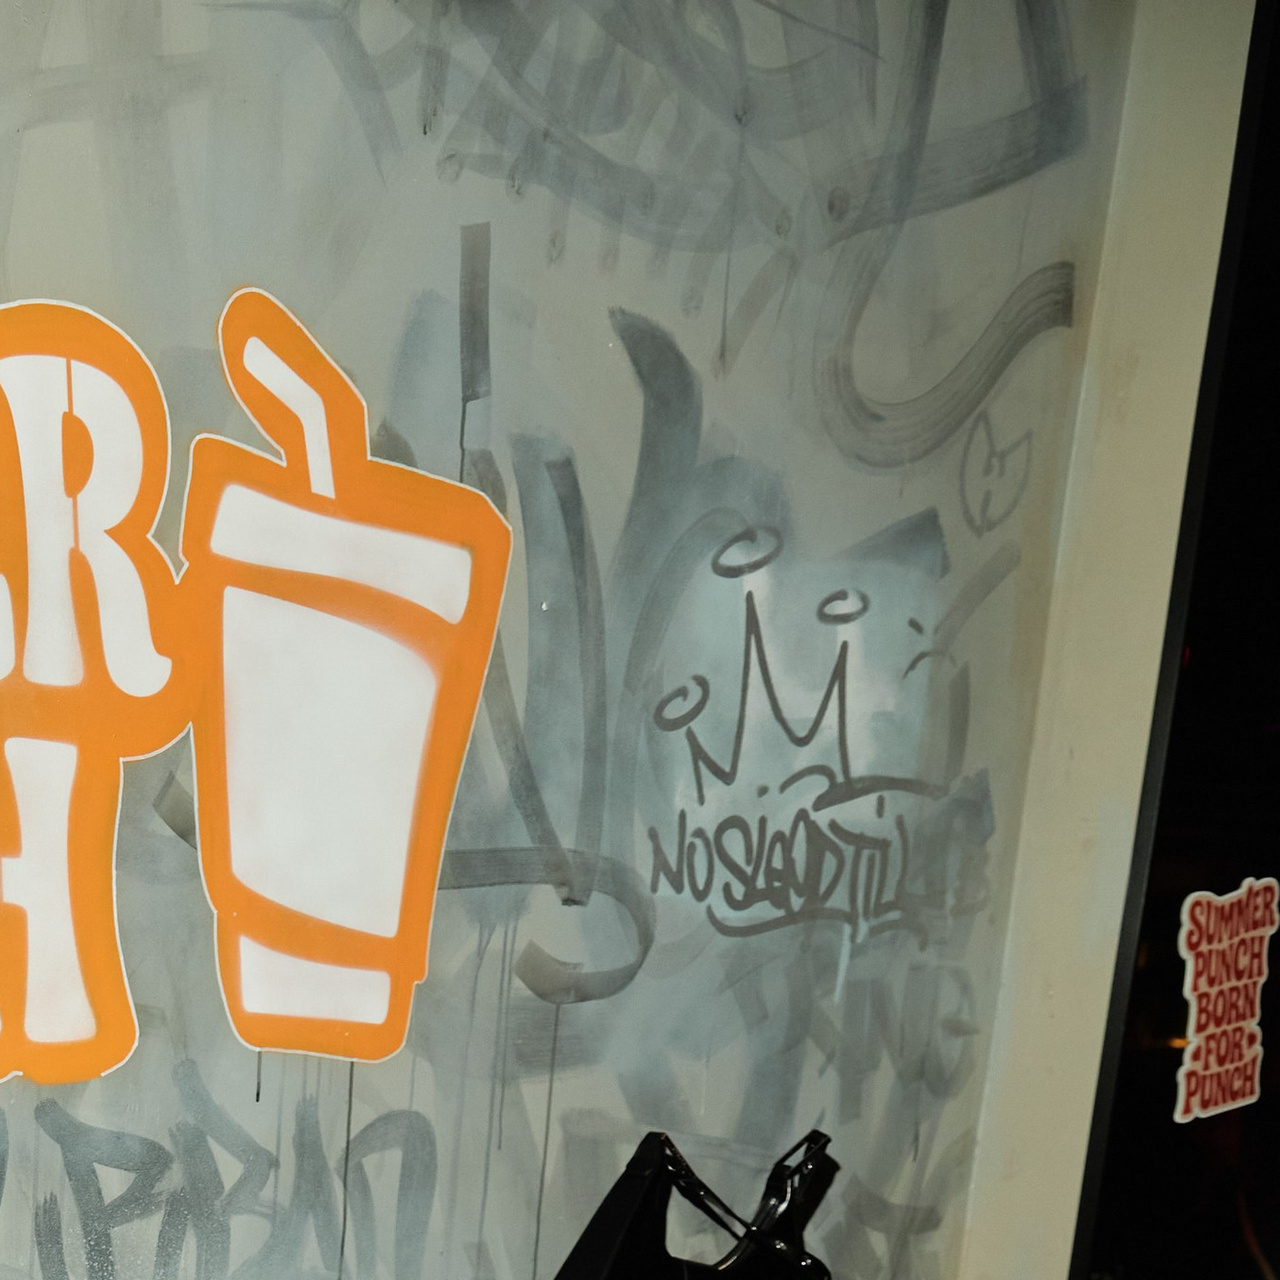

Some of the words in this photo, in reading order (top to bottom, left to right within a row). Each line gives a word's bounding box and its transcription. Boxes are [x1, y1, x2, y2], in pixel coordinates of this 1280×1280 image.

[1186, 884, 1277, 952] SUMMER
[1192, 934, 1265, 992] PUNCH
[1194, 980, 1257, 1034] BORN
[1203, 1026, 1244, 1071] FOR
[1181, 1053, 1257, 1116] PUNCH
